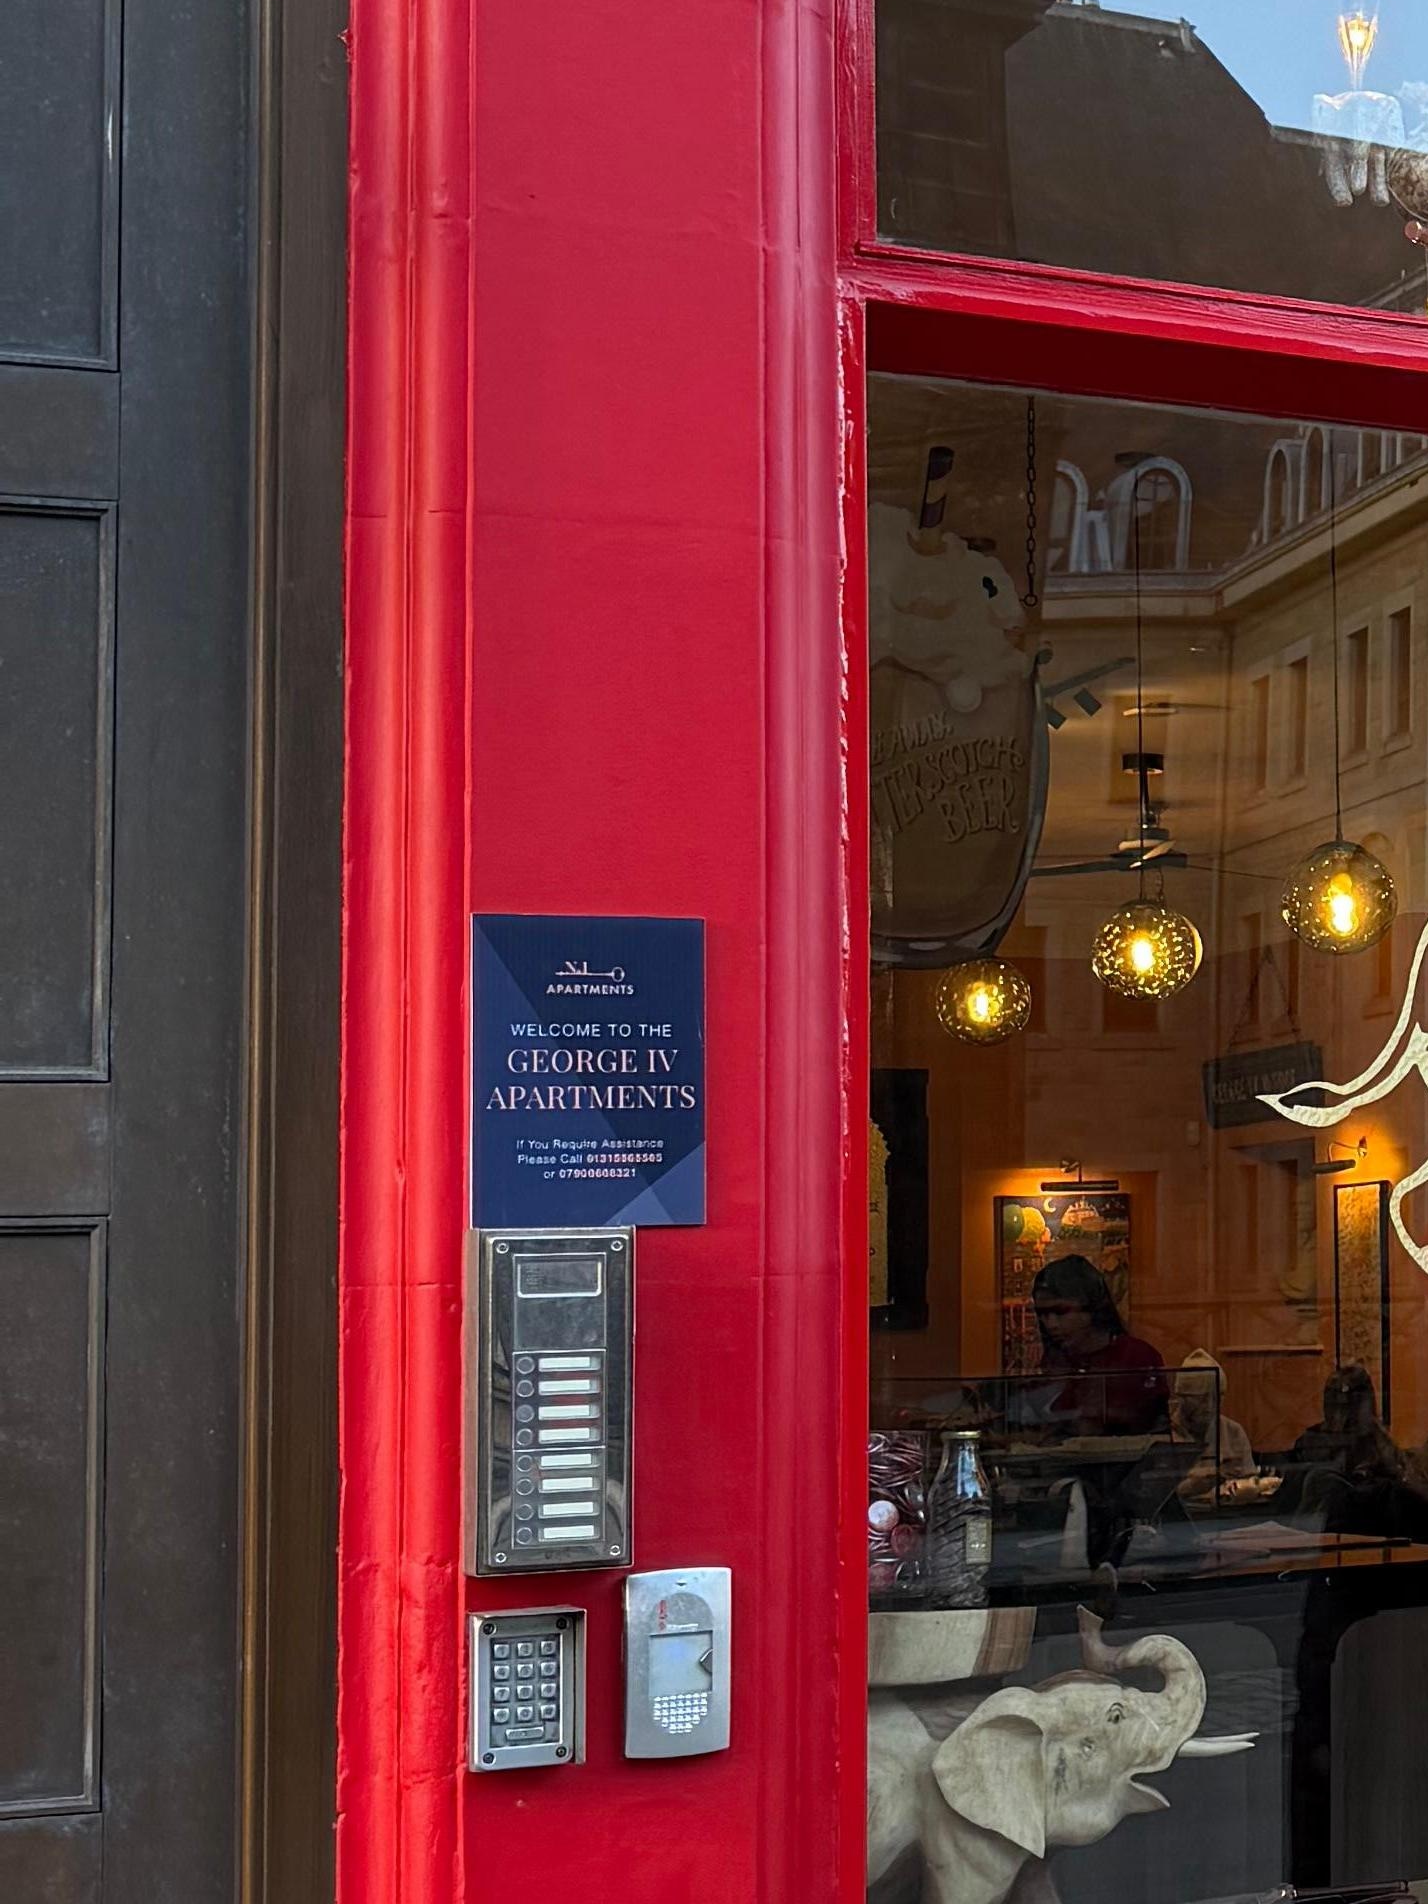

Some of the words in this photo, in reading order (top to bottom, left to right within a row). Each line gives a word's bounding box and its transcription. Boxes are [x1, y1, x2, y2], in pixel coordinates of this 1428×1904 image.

[940, 776, 1021, 843] BEER
[546, 984, 634, 995] APARTMENTS
[511, 1024, 600, 1037] WELCOME
[608, 1024, 631, 1037] TO
[639, 1024, 672, 1037] THE
[507, 1049, 637, 1073] GEORGE
[648, 1049, 678, 1073] IV
[486, 1085, 696, 1110] APARTMENTS
[517, 1139, 523, 1149] If
[527, 1139, 549, 1150] You
[554, 1139, 597, 1151] Require
[602, 1138, 664, 1149] Assistance
[518, 1153, 556, 1164] Please
[560, 1153, 583, 1164] Call
[544, 1170, 555, 1179] or
